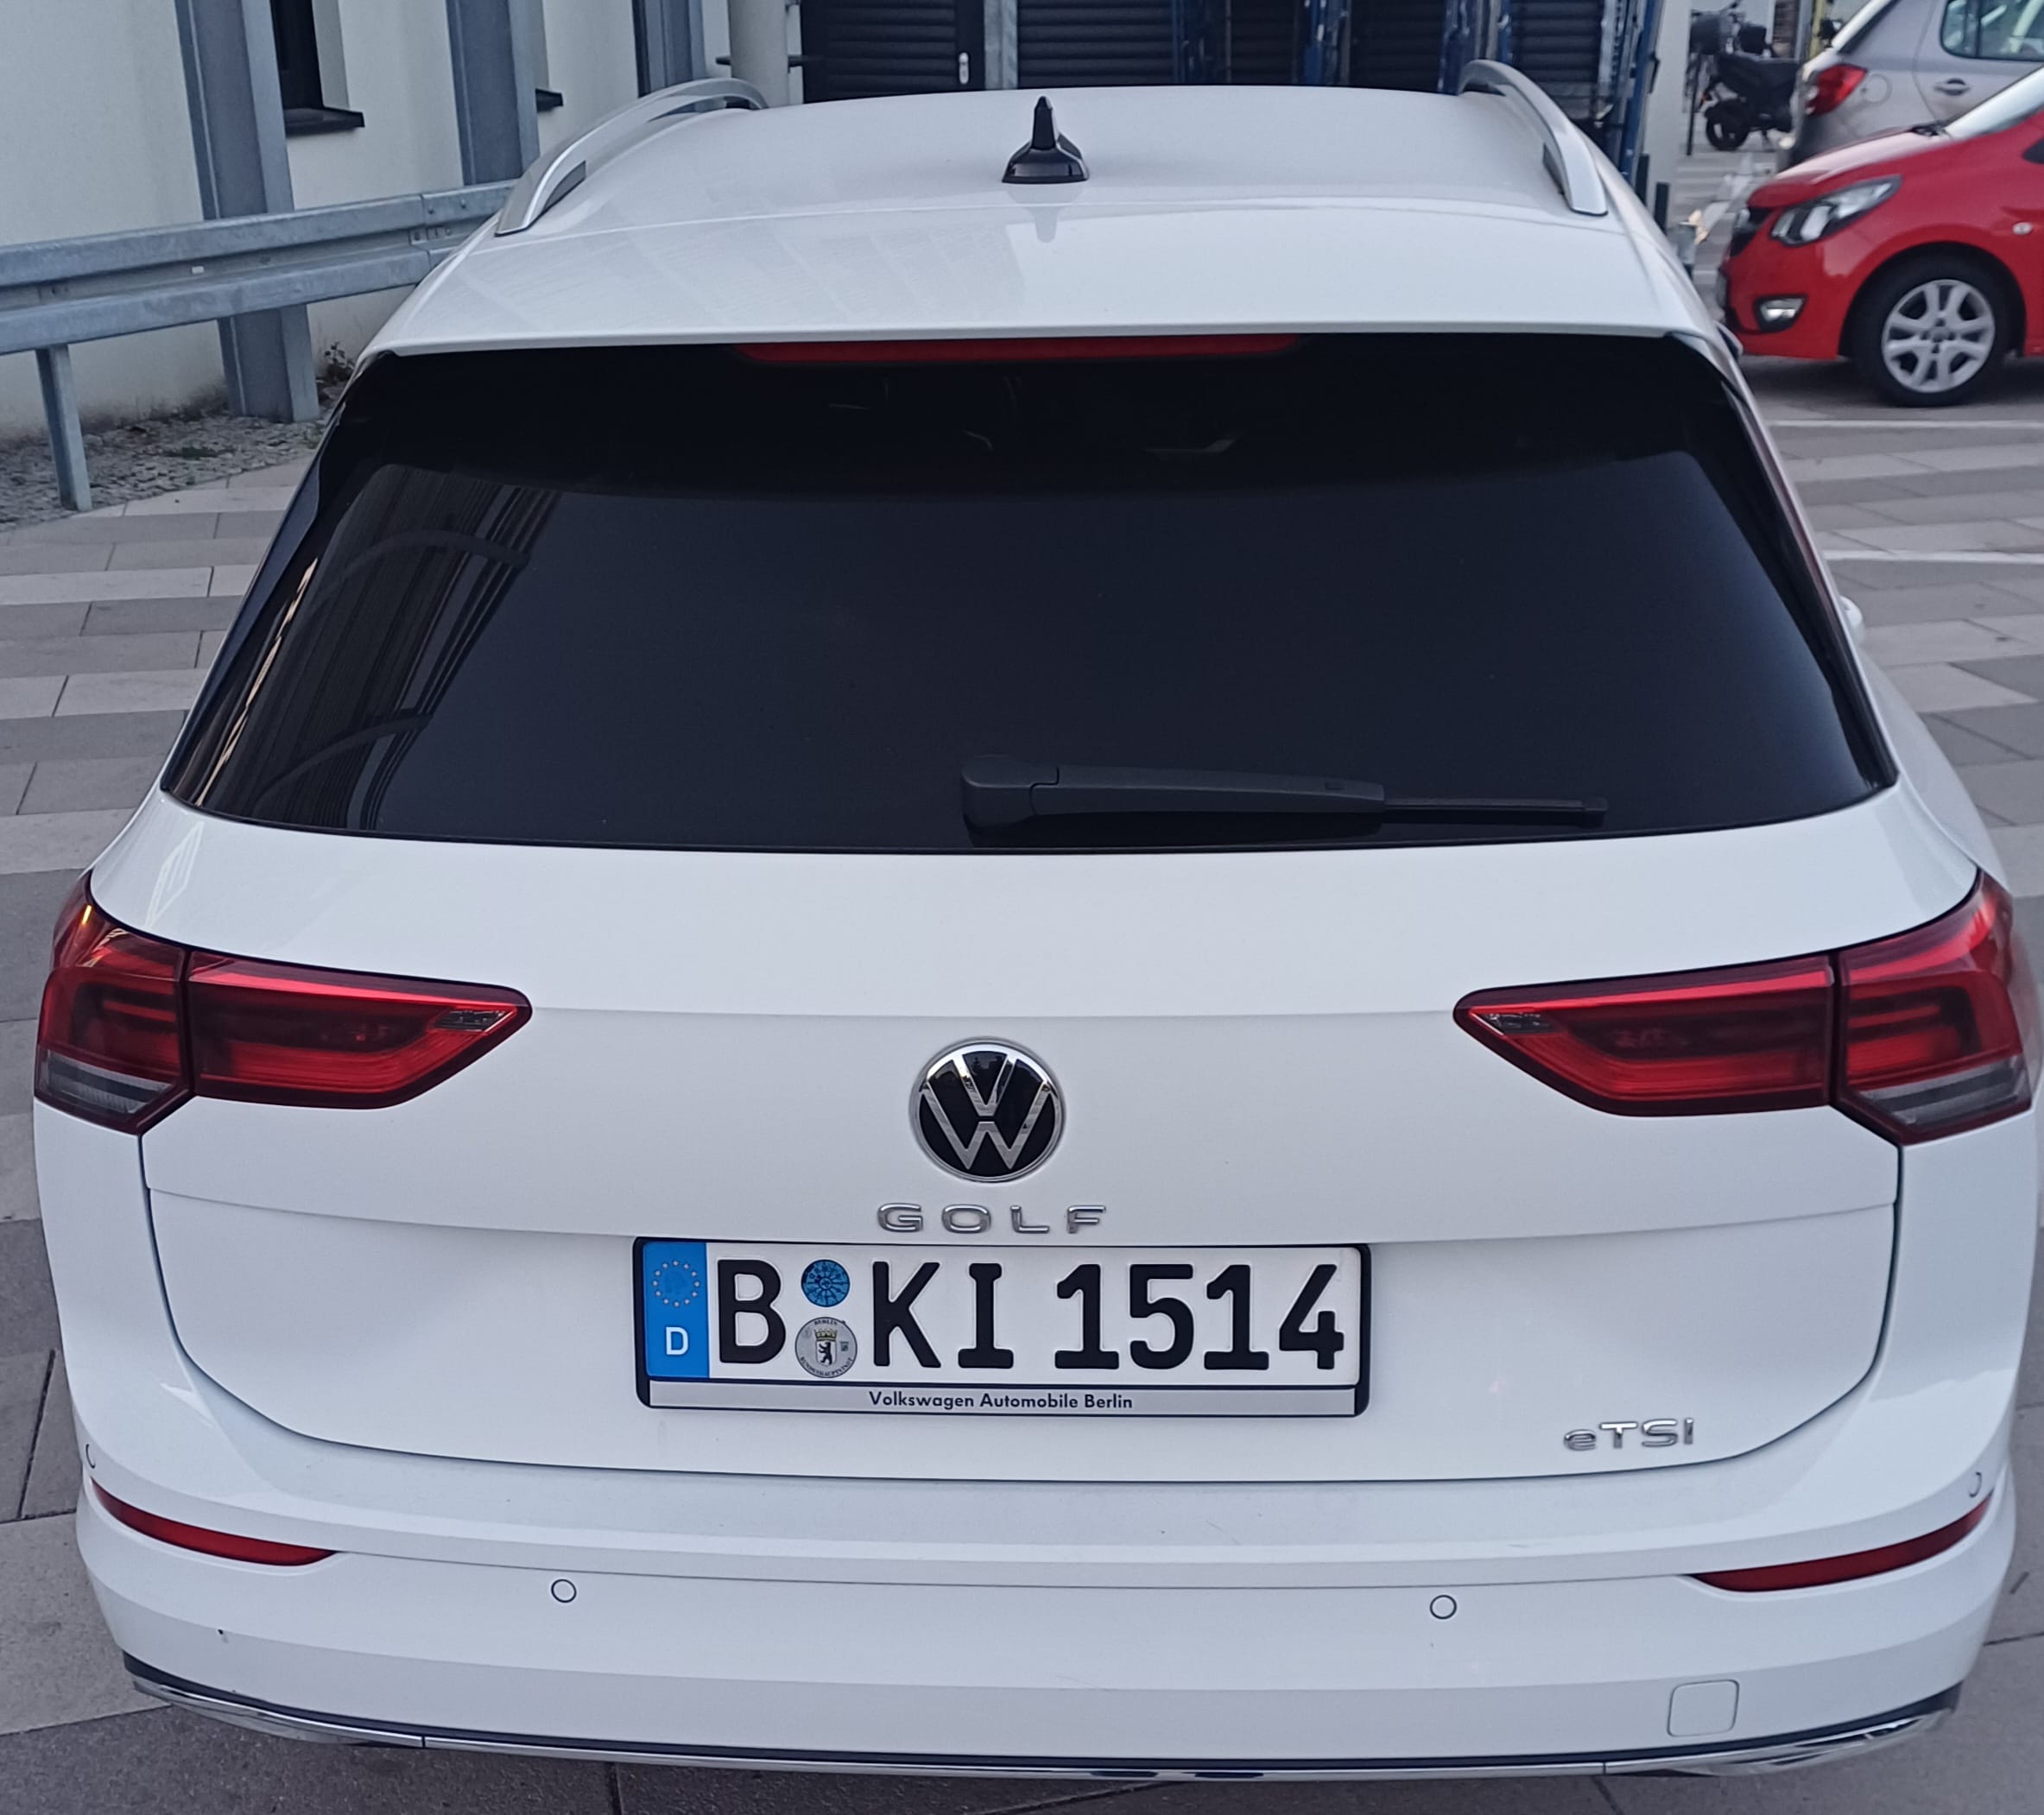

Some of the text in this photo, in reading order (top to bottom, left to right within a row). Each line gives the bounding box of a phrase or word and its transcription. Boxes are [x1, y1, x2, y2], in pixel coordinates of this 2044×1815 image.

[876, 1203, 1107, 1235] GOLF
[716, 1259, 1345, 1371] B KI 1514
[665, 1326, 689, 1356] D
[868, 1390, 1133, 1411] Volkswagen Automobile Berlin
[1563, 1417, 1694, 1451] eTSI
